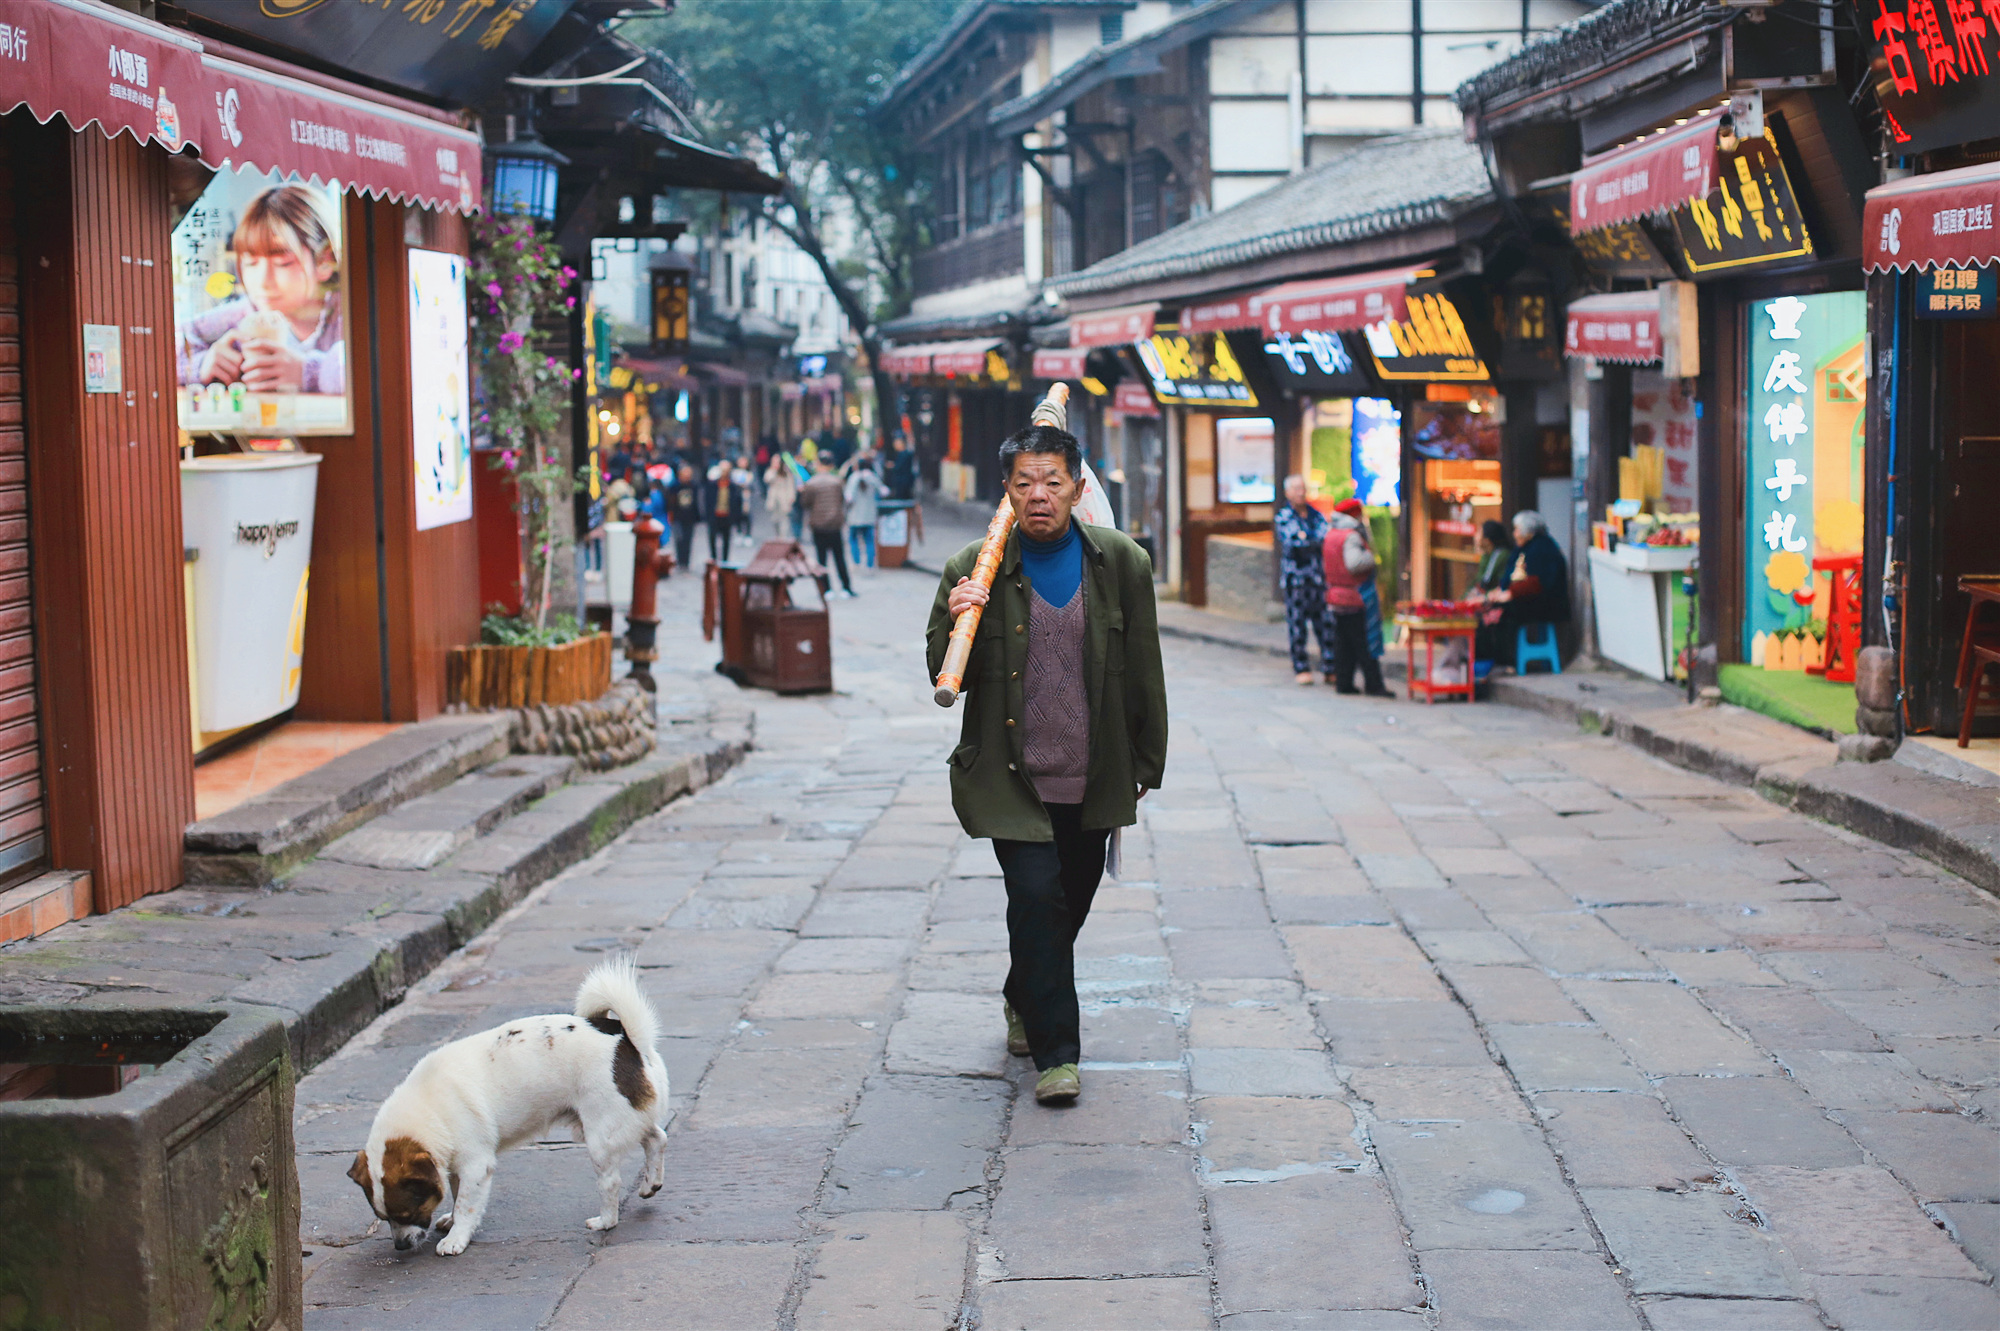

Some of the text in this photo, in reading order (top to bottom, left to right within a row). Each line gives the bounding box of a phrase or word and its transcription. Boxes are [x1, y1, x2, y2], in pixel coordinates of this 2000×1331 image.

[108, 44, 149, 88] 小郎酒
[1933, 269, 1978, 290] 招聘
[1929, 294, 1982, 311] 服务员
[1762, 296, 1808, 552] 重庆伴手礼
